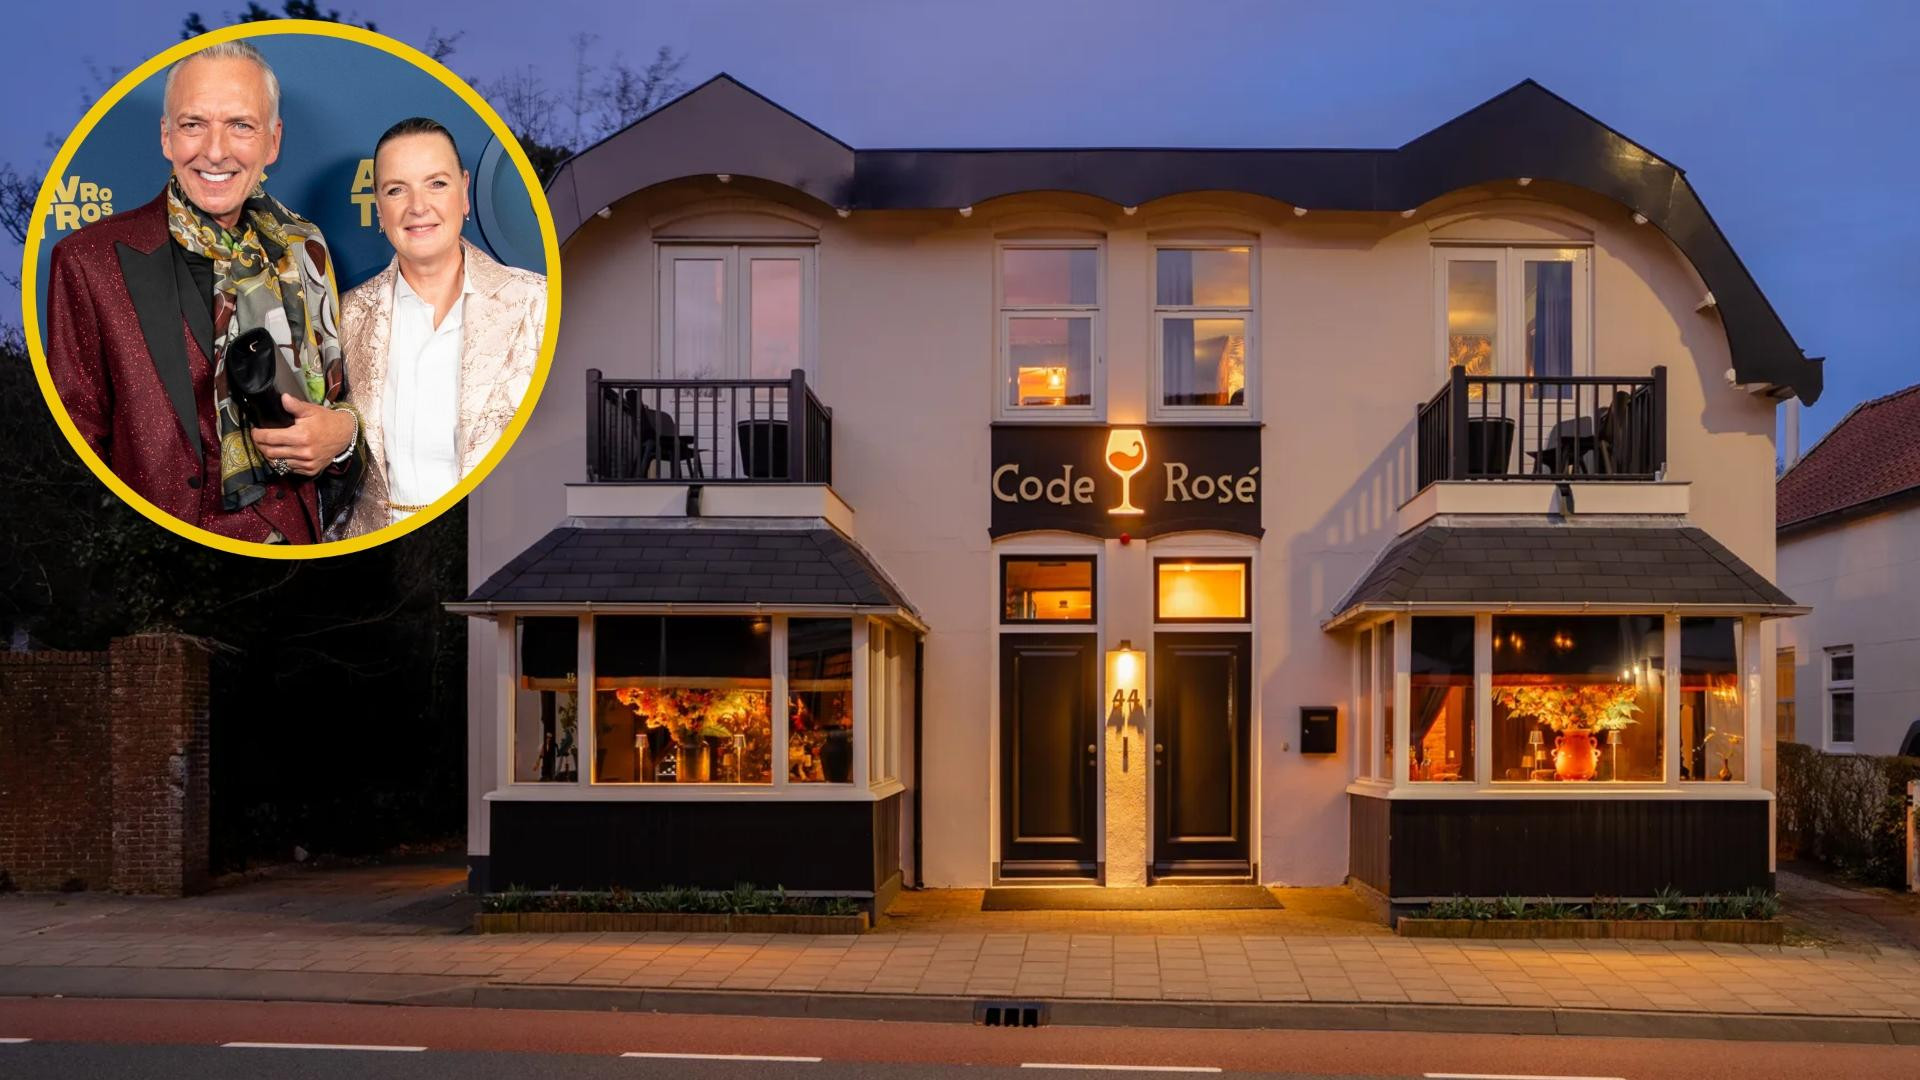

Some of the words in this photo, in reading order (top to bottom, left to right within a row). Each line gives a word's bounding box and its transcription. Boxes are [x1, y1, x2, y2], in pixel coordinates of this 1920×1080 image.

[53, 176, 113, 203] VRO
[41, 202, 114, 239] ROS
[992, 463, 1096, 505] Code
[1163, 462, 1260, 504] Rosé
[1112, 688, 1140, 709] 44
